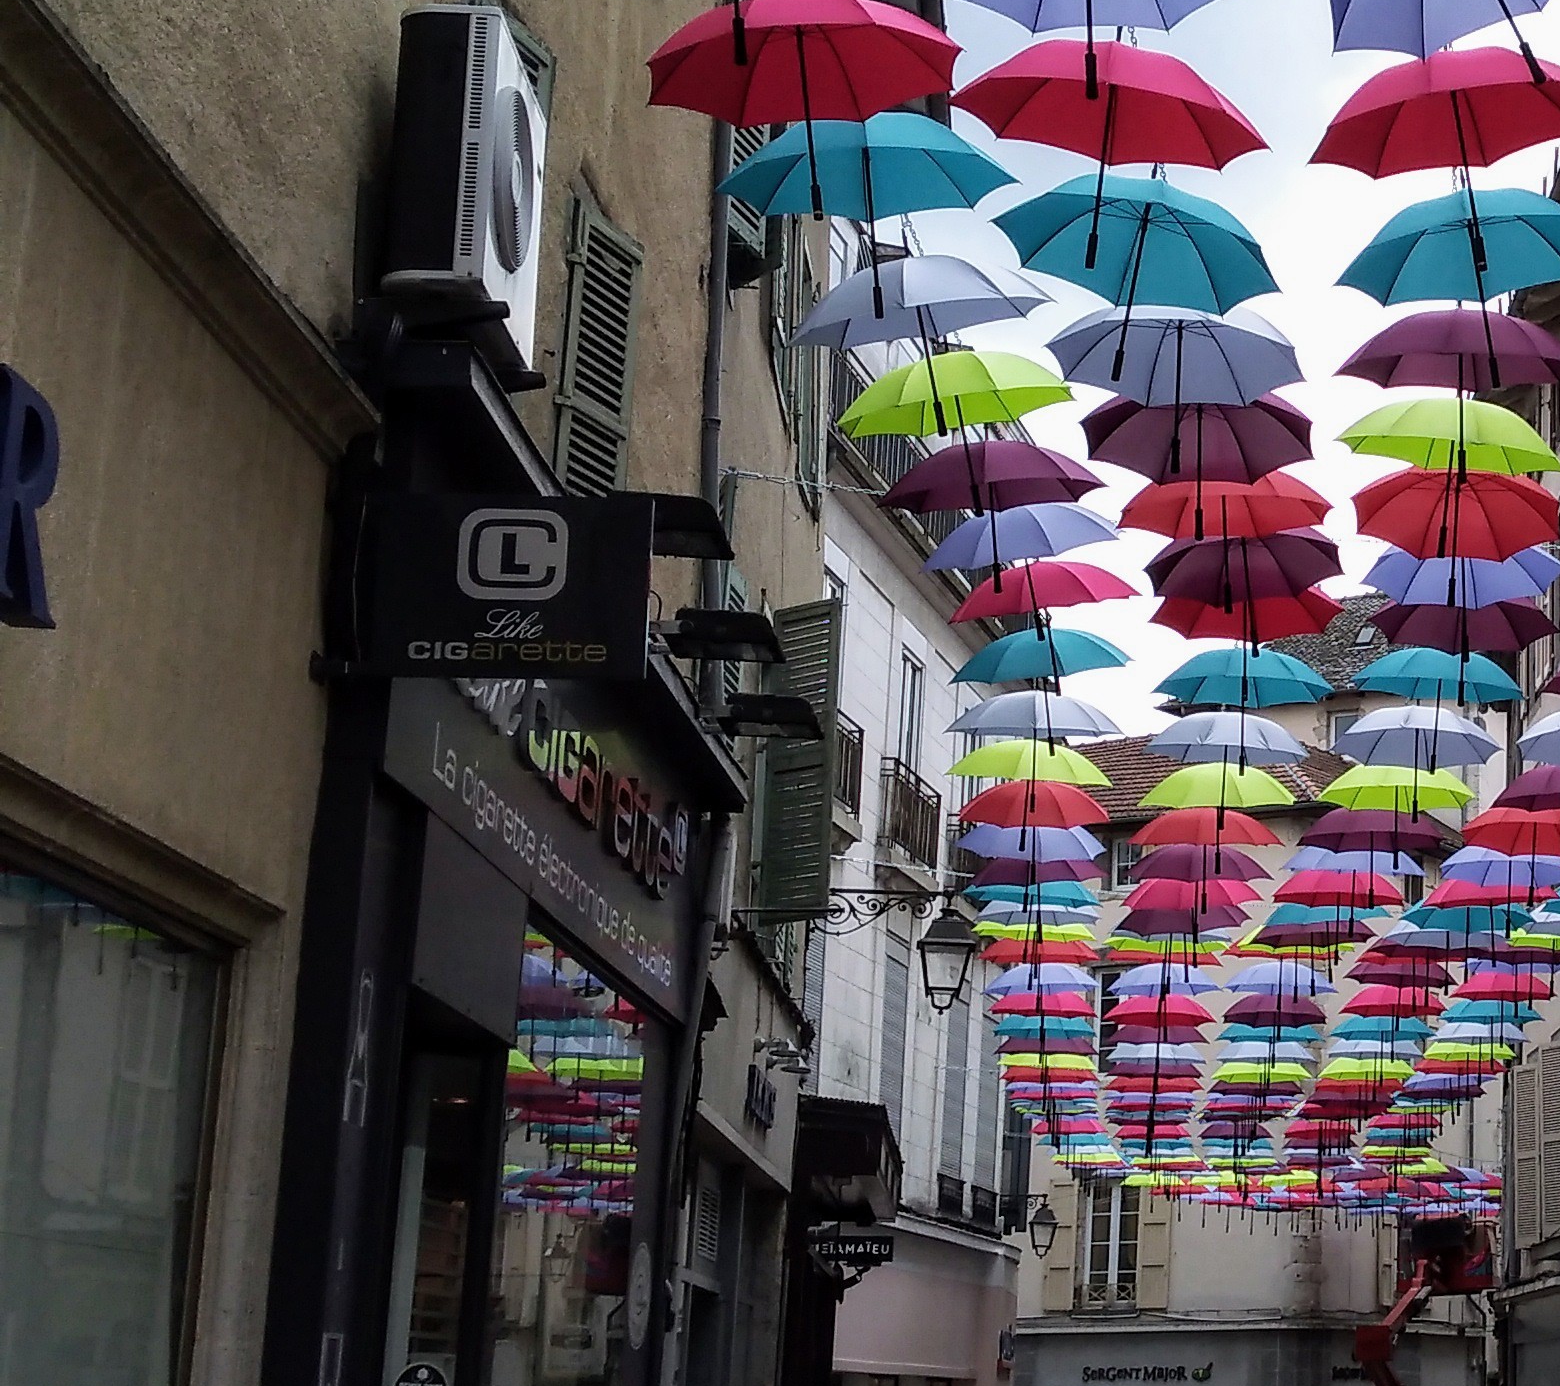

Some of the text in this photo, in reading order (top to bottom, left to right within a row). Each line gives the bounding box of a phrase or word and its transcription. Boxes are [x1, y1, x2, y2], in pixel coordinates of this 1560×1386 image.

[473, 609, 544, 640] Like
[432, 720, 458, 793] La
[461, 759, 537, 867] cigarette
